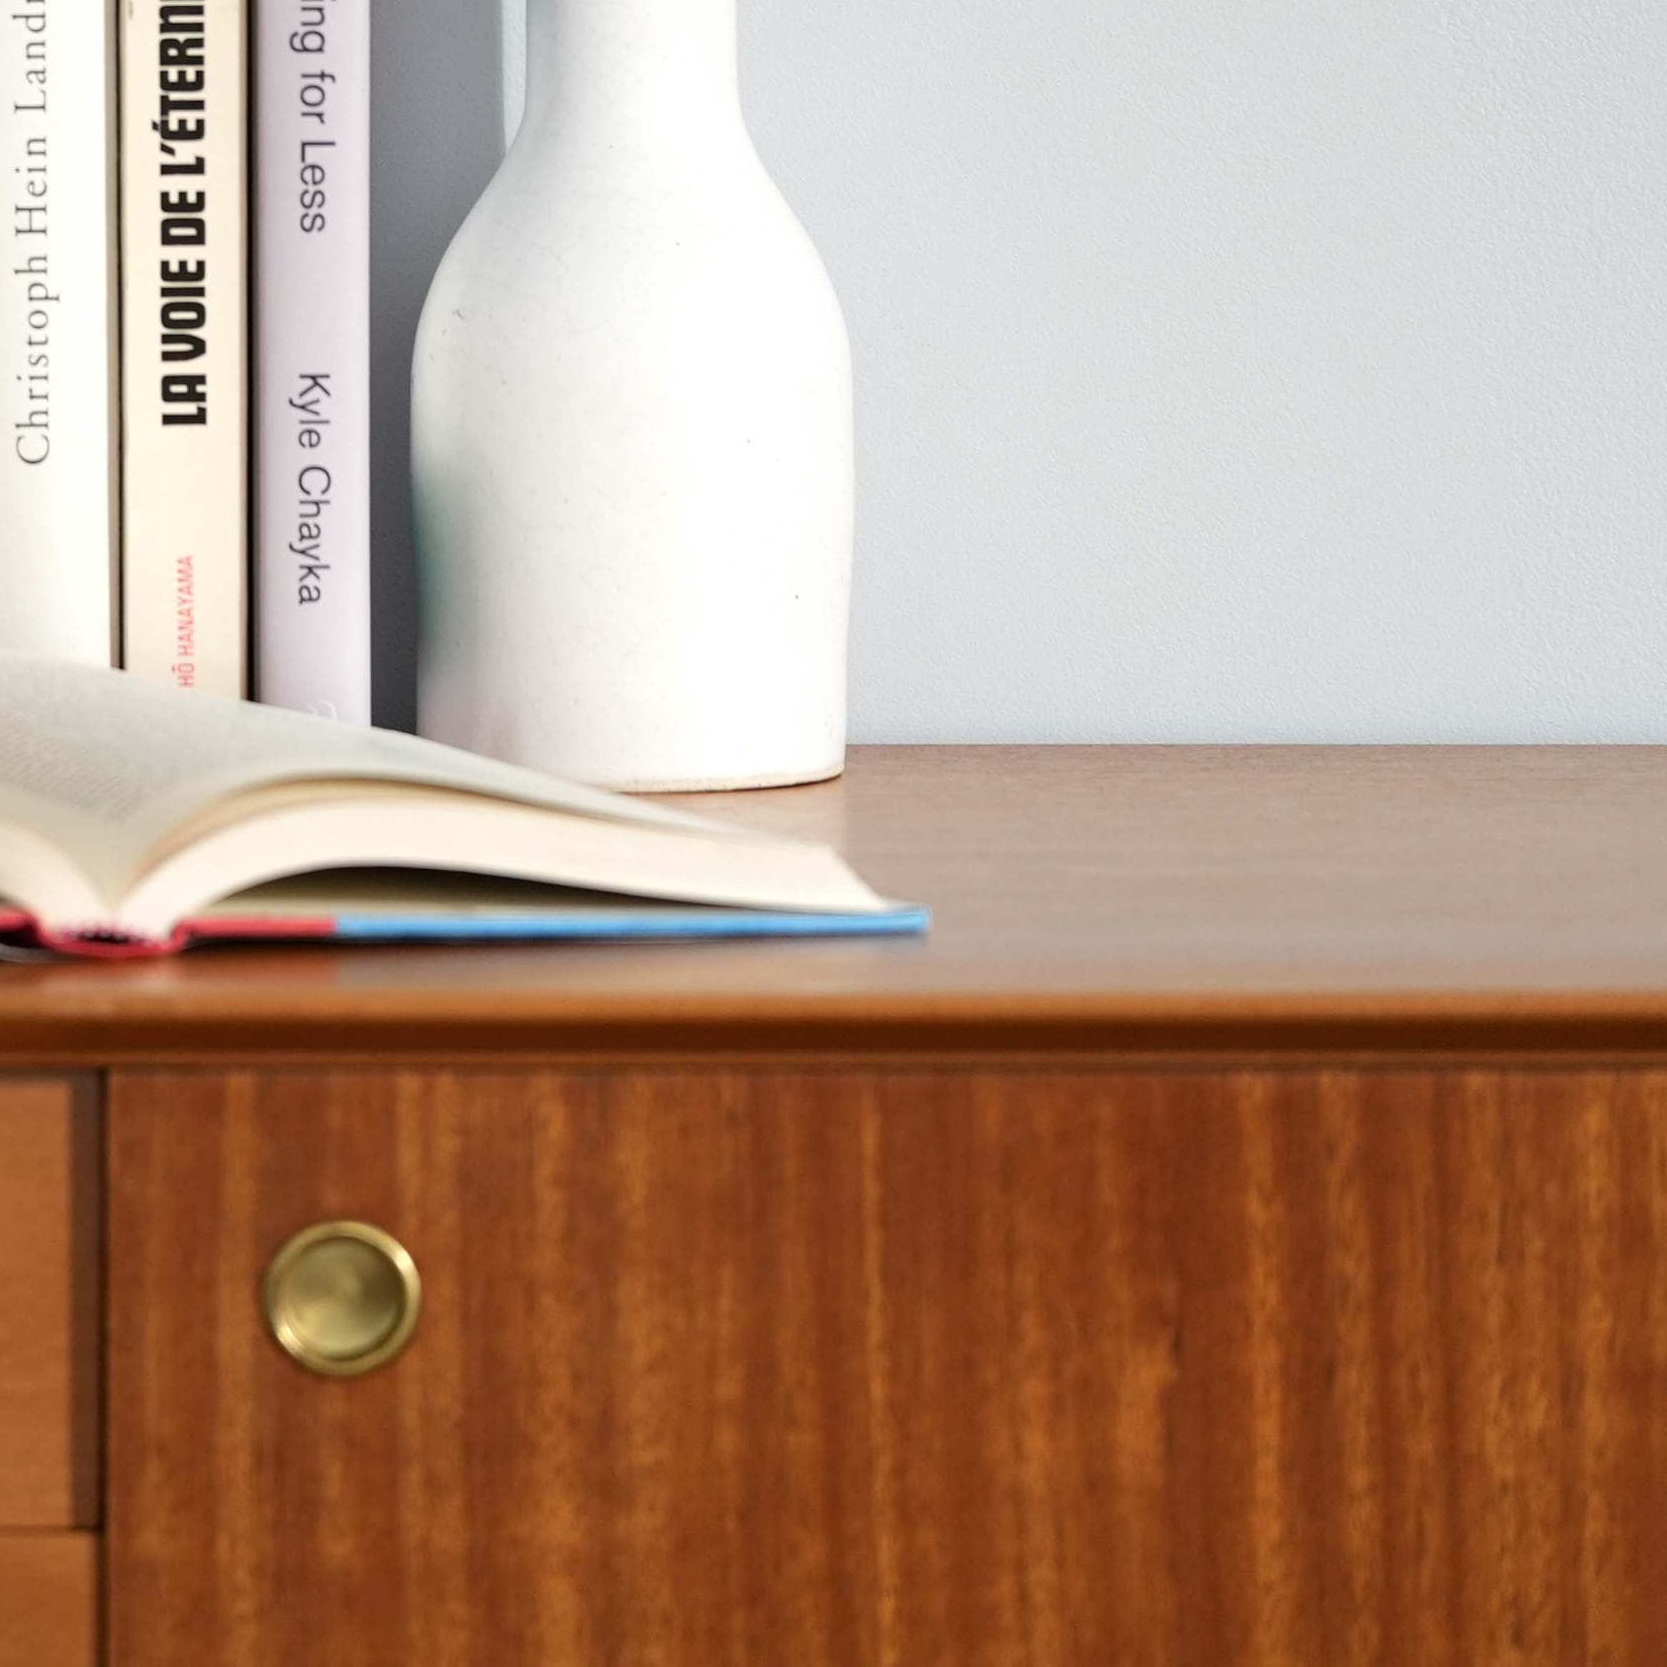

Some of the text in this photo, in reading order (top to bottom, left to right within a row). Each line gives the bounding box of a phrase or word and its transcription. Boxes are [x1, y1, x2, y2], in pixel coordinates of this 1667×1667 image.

[299, 69, 336, 124] for
[14, 137, 48, 237] Hein
[160, 191, 207, 246] DE
[299, 141, 336, 233] Less
[14, 253, 60, 466] Christoph
[161, 259, 207, 362] VOIE
[161, 374, 207, 426] LA
[288, 373, 332, 605] Kyle Chayka
[176, 555, 195, 657] HANAYAMA
